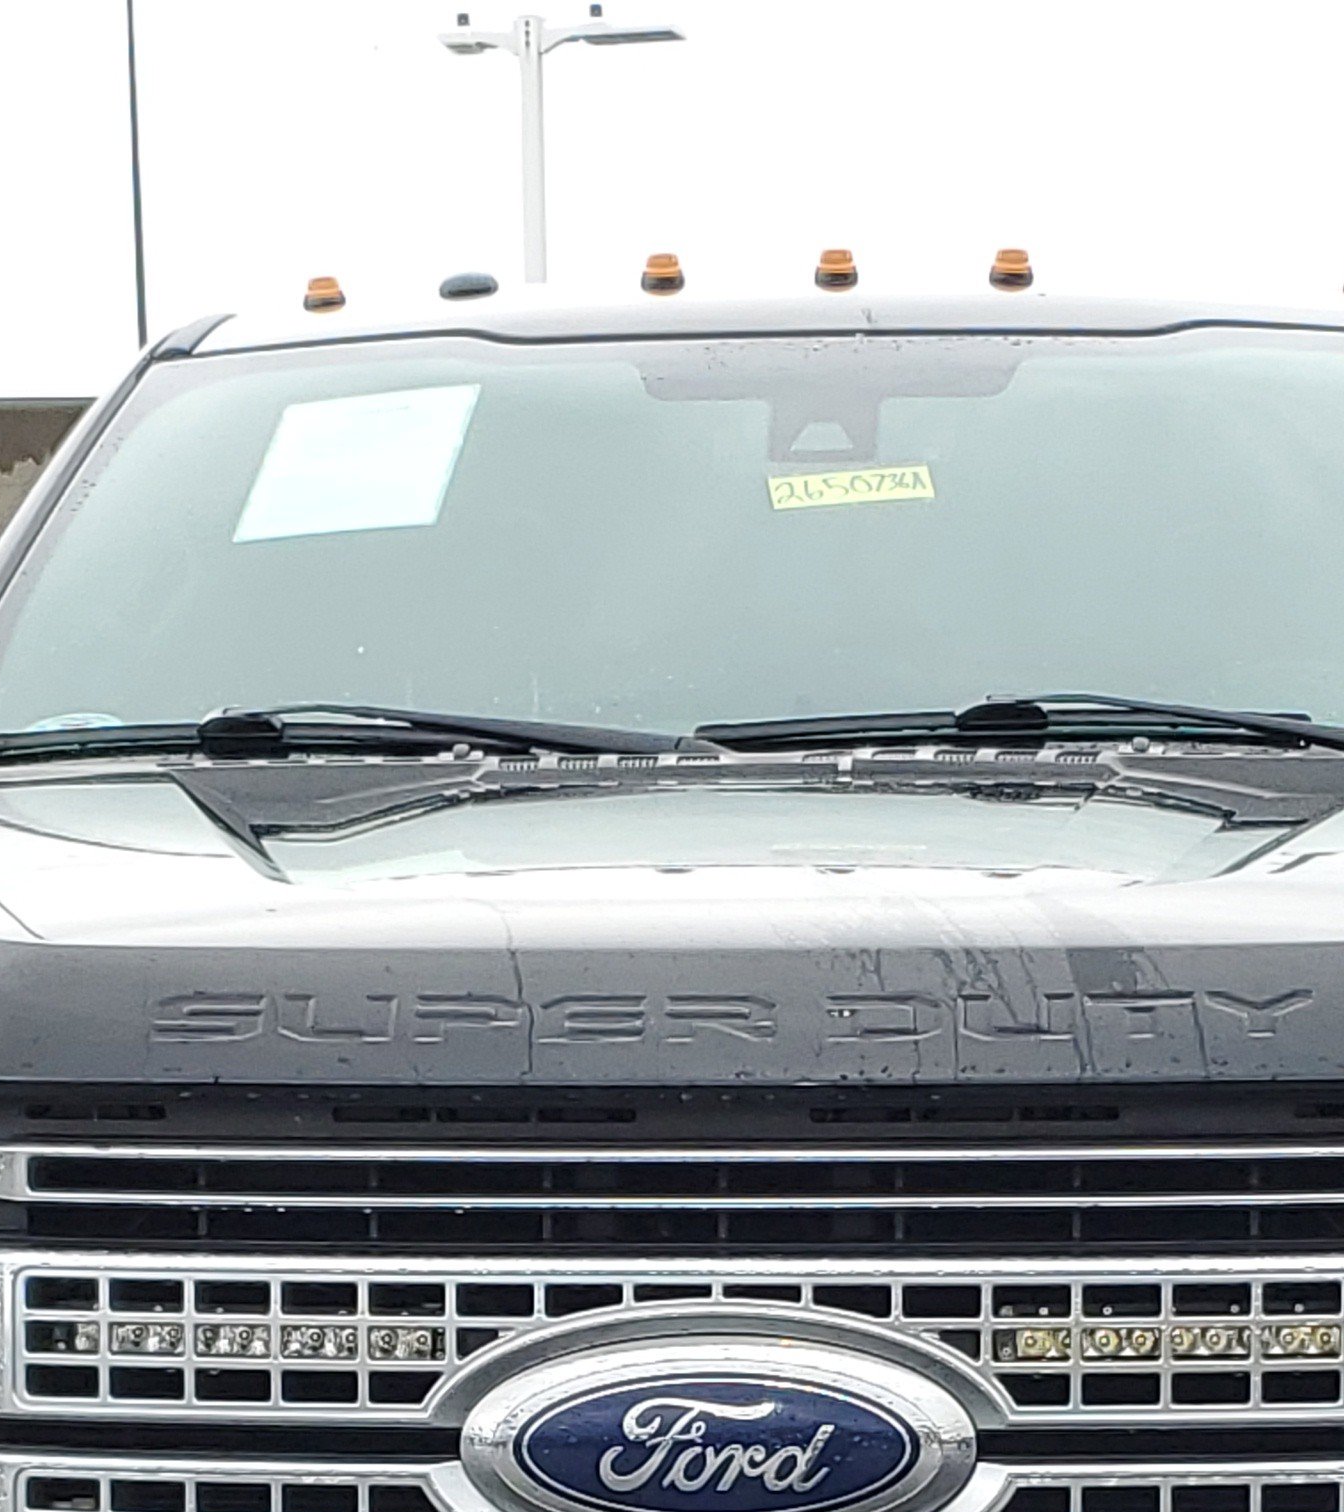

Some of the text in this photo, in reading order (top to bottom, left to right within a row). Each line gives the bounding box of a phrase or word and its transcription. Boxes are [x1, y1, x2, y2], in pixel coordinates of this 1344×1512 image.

[152, 989, 1315, 1042] SUPER DUTY
[598, 1397, 835, 1492] Ford
